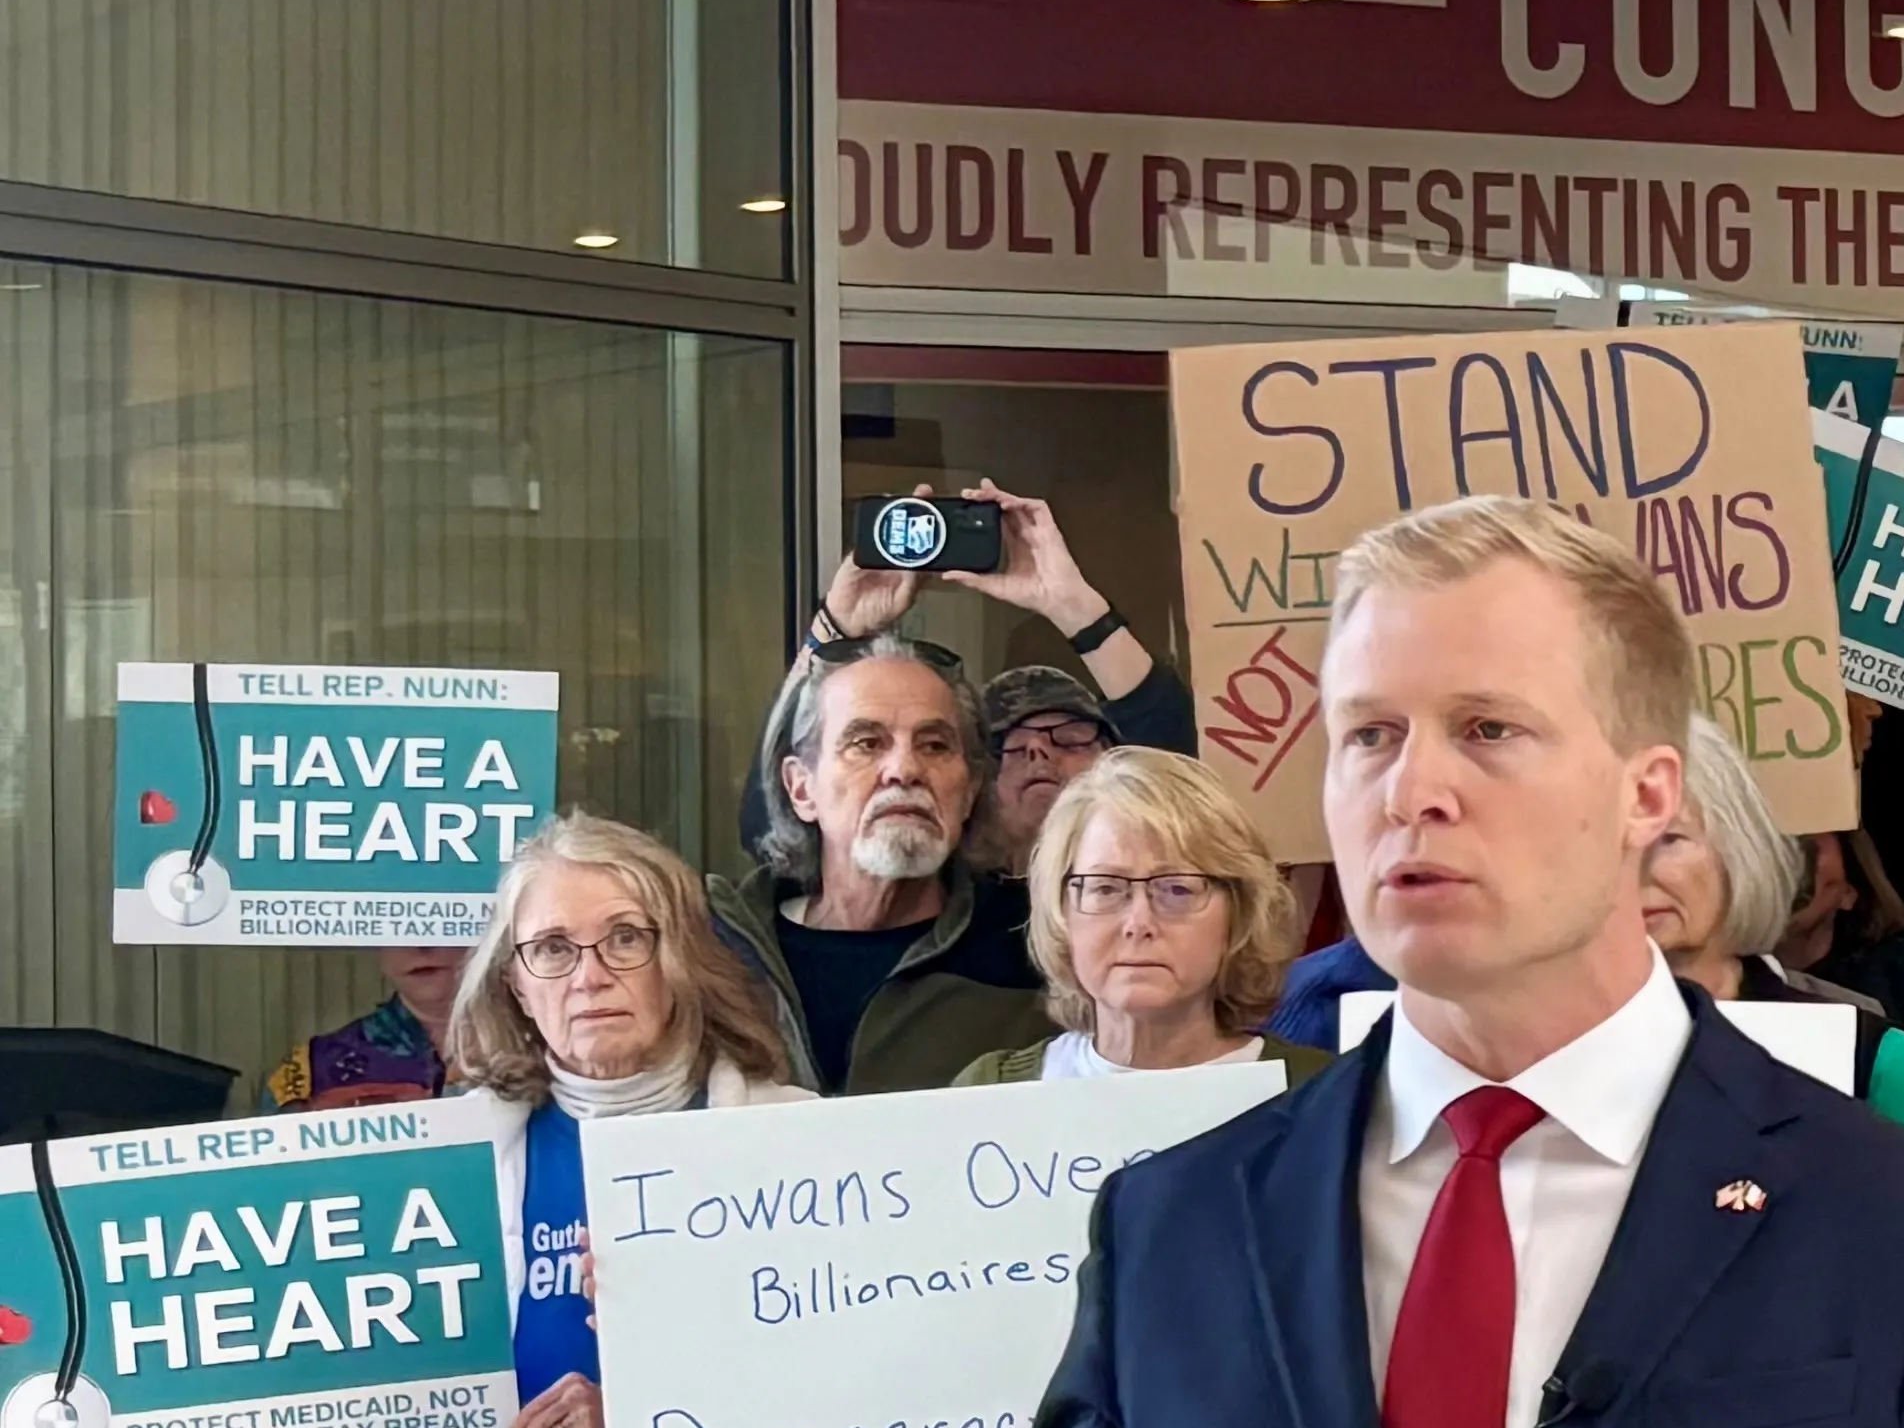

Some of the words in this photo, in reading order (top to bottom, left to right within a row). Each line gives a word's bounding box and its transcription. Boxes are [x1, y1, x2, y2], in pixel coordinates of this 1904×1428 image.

[1142, 154, 1752, 283] REPRESENTING
[1242, 341, 1710, 515] STAND
[1202, 527, 1341, 612] WI
[238, 673, 315, 698] TELL
[321, 673, 395, 700] REP.
[403, 675, 509, 703] NUNN:
[1203, 625, 1320, 766] NOT
[238, 733, 447, 789] HAVE
[464, 737, 519, 791] A
[237, 799, 534, 864] HEART
[239, 898, 346, 919] PROTECT
[349, 898, 476, 921] MEDICAID,
[239, 919, 384, 937] BILLIONAIRE
[388, 920, 437, 938] TAX
[90, 1140, 187, 1172] TELL
[198, 1127, 288, 1162] REP.
[299, 1113, 430, 1151] NUNN:
[100, 1195, 365, 1284] HAVE
[391, 1187, 457, 1253] A
[612, 1168, 912, 1244] Iowans
[110, 1262, 481, 1376] HEART
[751, 1251, 1070, 1324] Billionaires
[269, 1392, 422, 1428] MEDICAID,
[428, 1384, 489, 1410] NOT
